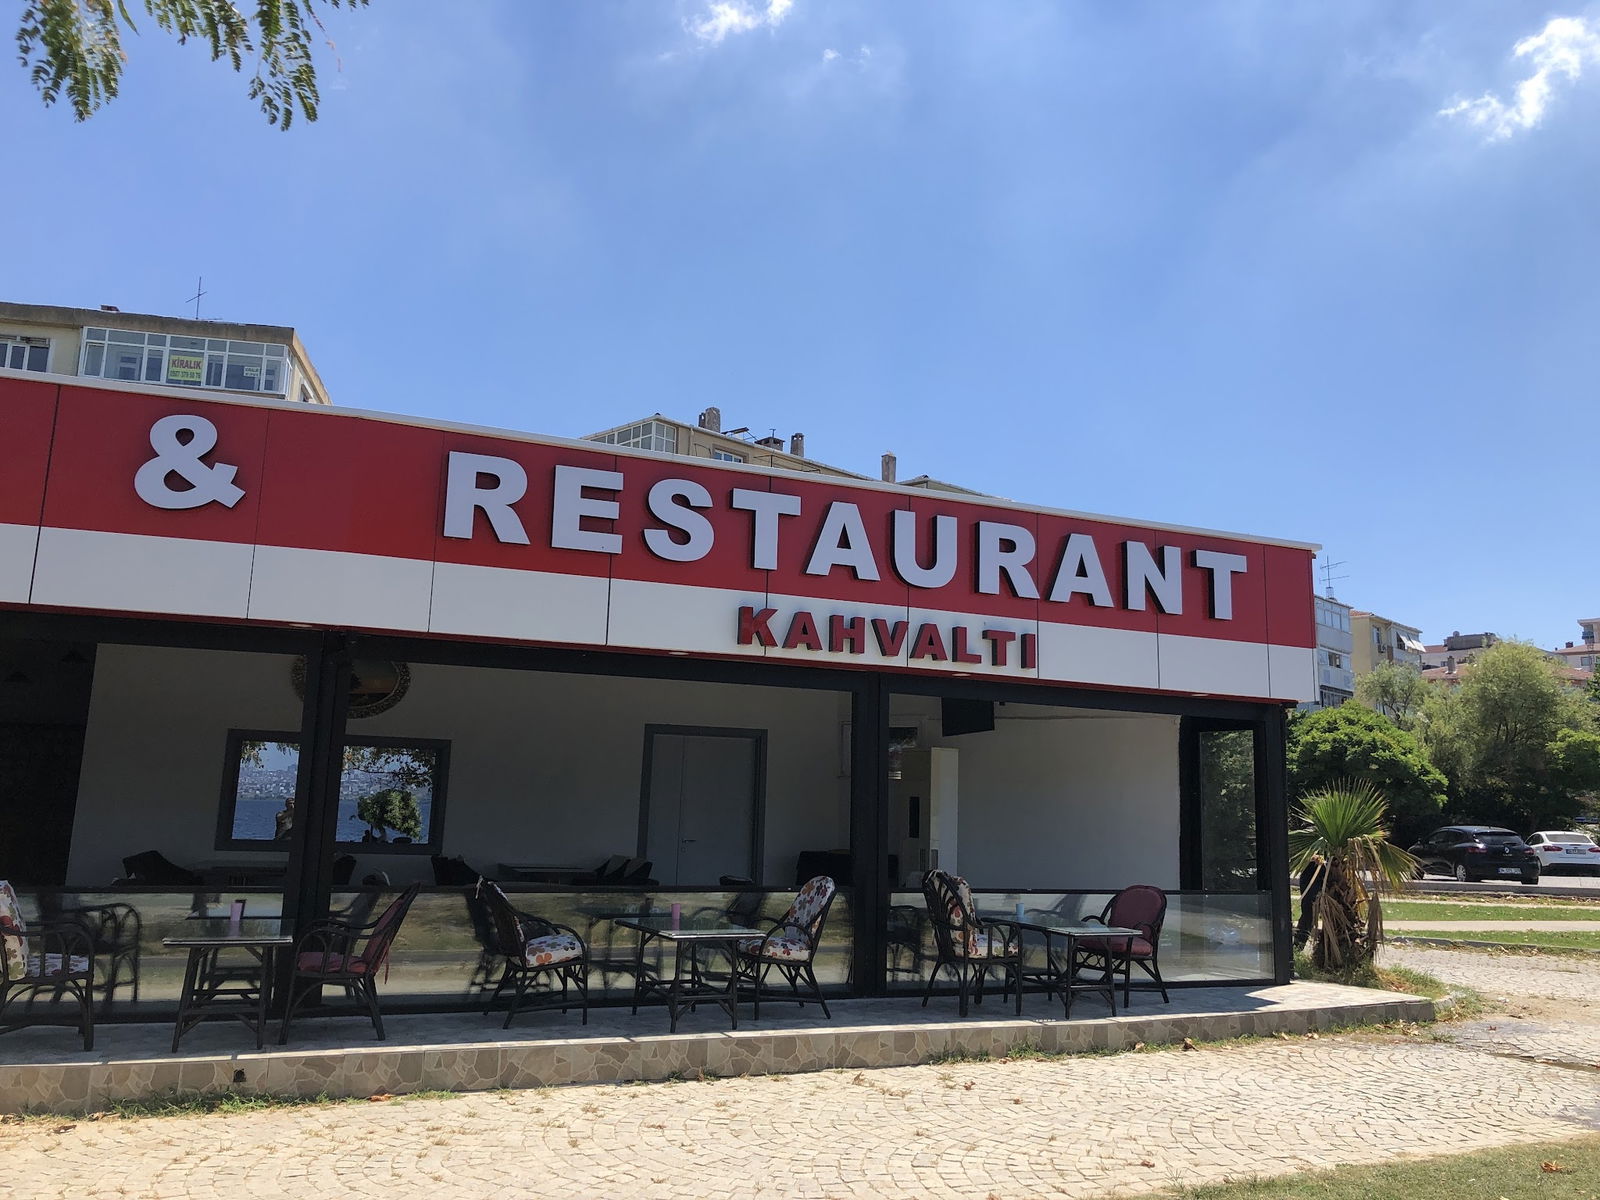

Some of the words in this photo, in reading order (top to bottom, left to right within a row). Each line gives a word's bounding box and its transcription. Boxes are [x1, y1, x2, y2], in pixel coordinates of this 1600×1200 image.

[171, 357, 202, 370] KİRALIK
[134, 413, 246, 510] &
[442, 450, 1249, 621] RESTAURANT
[738, 606, 1037, 670] KAHVALTI
